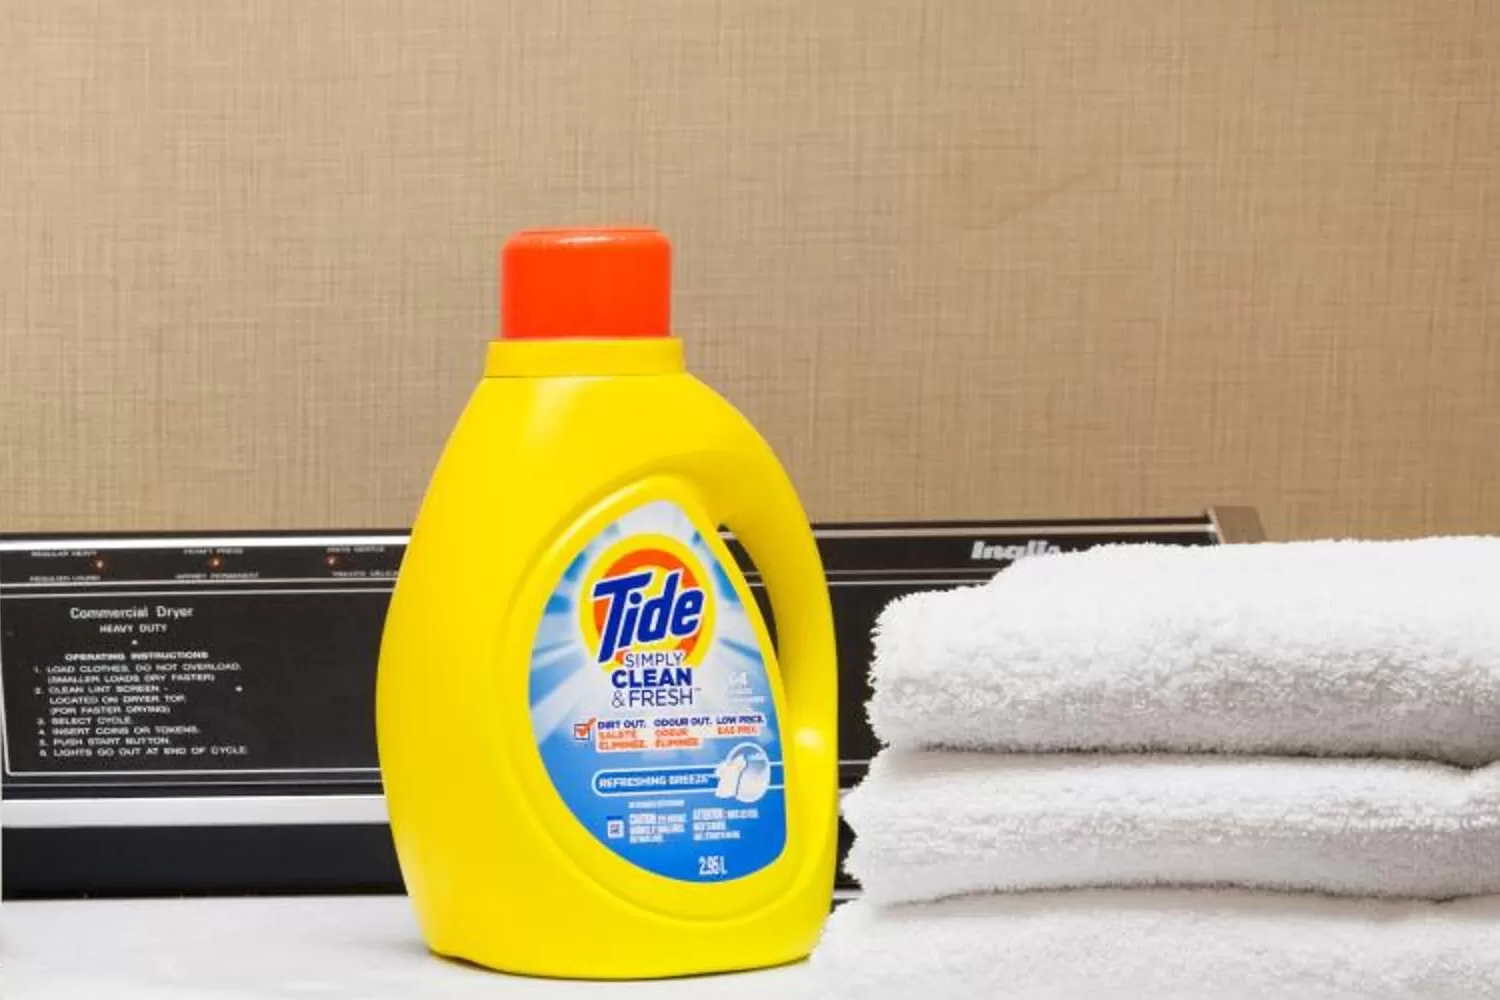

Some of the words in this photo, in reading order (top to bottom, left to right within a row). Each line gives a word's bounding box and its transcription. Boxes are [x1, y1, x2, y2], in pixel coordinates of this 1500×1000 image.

[69, 606, 149, 620] Commercial
[155, 605, 194, 618] Dryer
[592, 570, 705, 664] Tide
[99, 624, 134, 634] HEAVY
[139, 623, 168, 633] DUTY
[64, 653, 126, 661] OPERATING
[130, 651, 209, 660] INSTRUCTIONS
[625, 653, 683, 668] SIMPLY
[611, 668, 693, 688] CLEAN
[611, 690, 626, 708] &
[629, 688, 693, 707] FRESH
[654, 718, 689, 727] ODOUR
[716, 716, 737, 725] LOW
